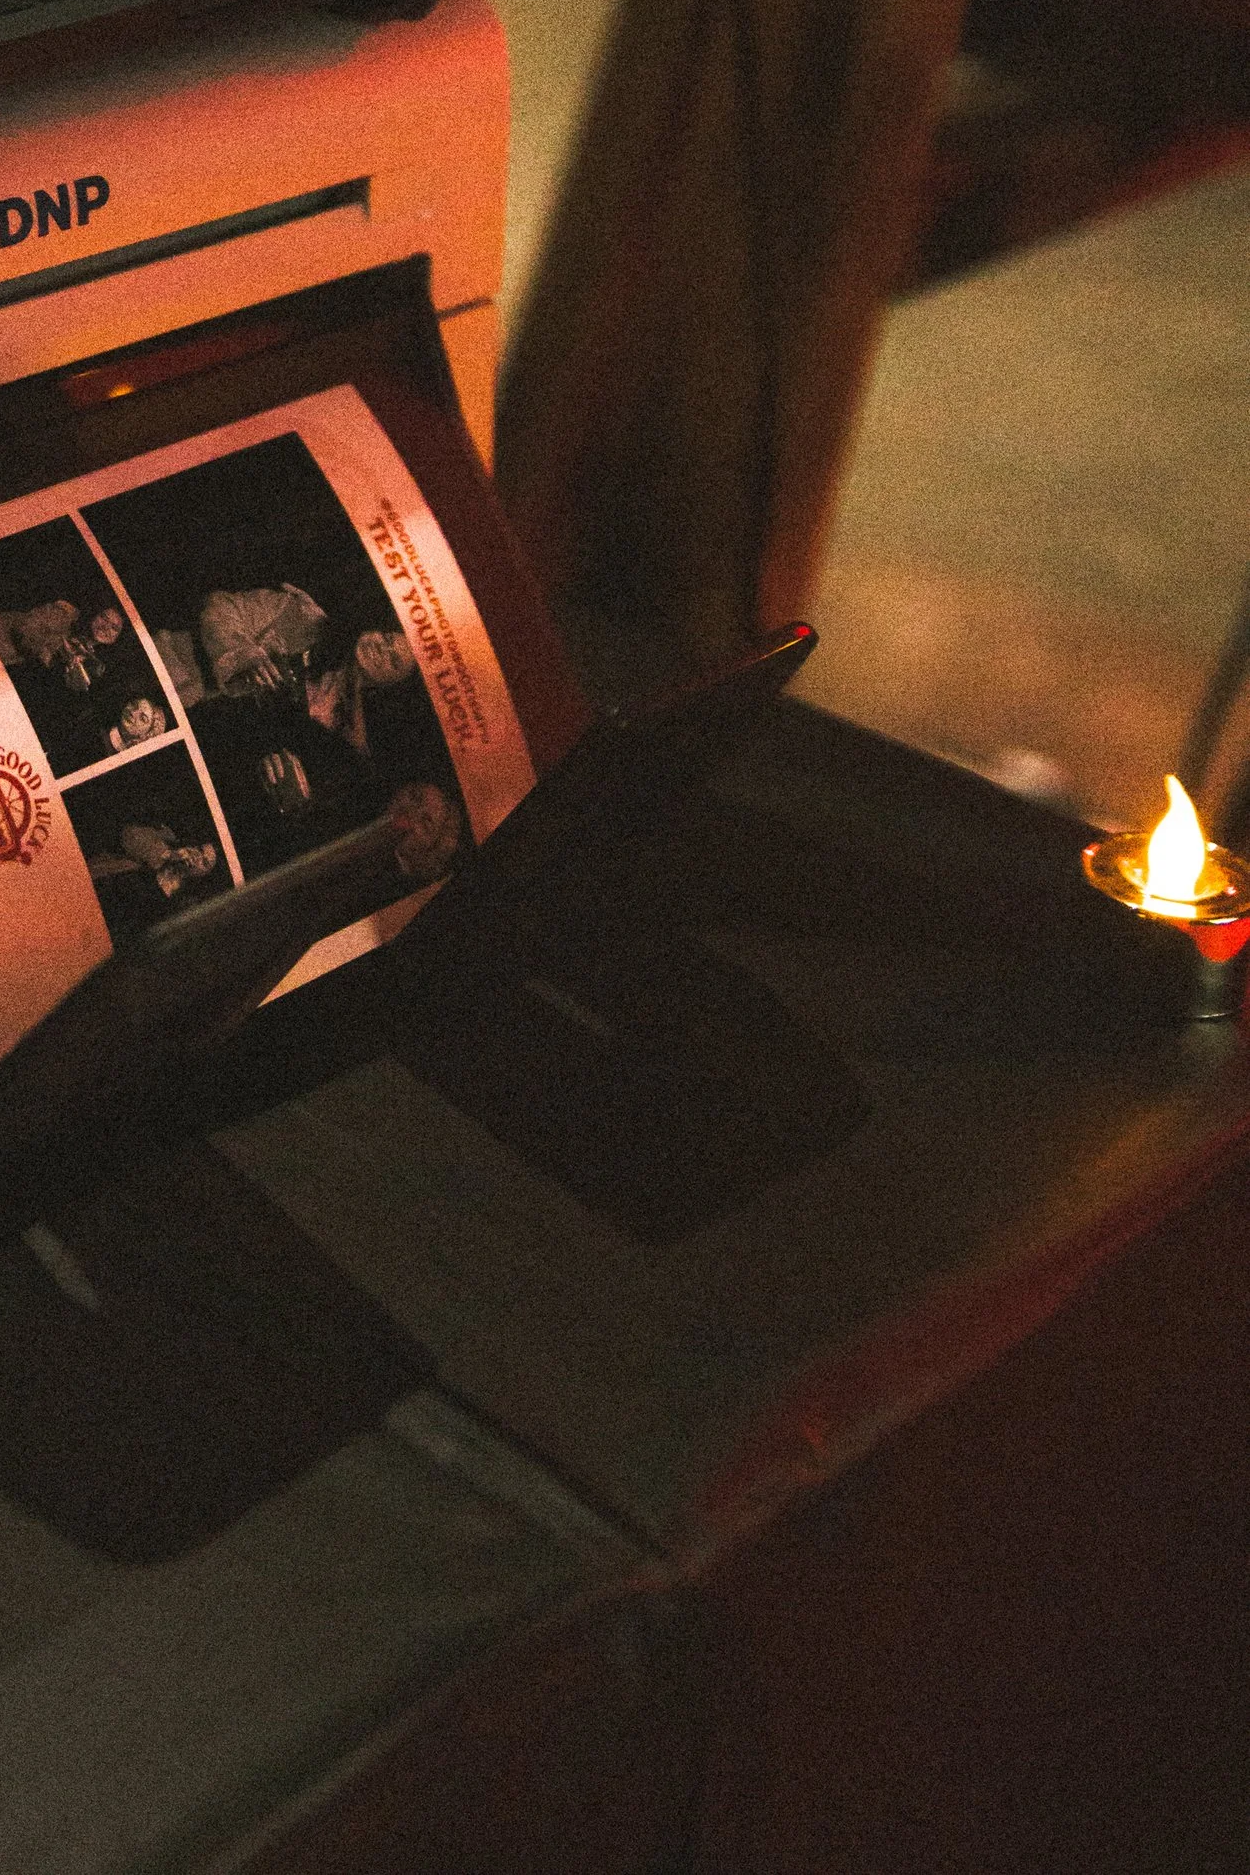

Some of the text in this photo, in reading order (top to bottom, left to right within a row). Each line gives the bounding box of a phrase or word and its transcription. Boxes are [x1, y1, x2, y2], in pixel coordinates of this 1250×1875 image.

[368, 516, 412, 581] TEST
[402, 587, 444, 662] YOUR
[26, 797, 52, 850] LUCK
